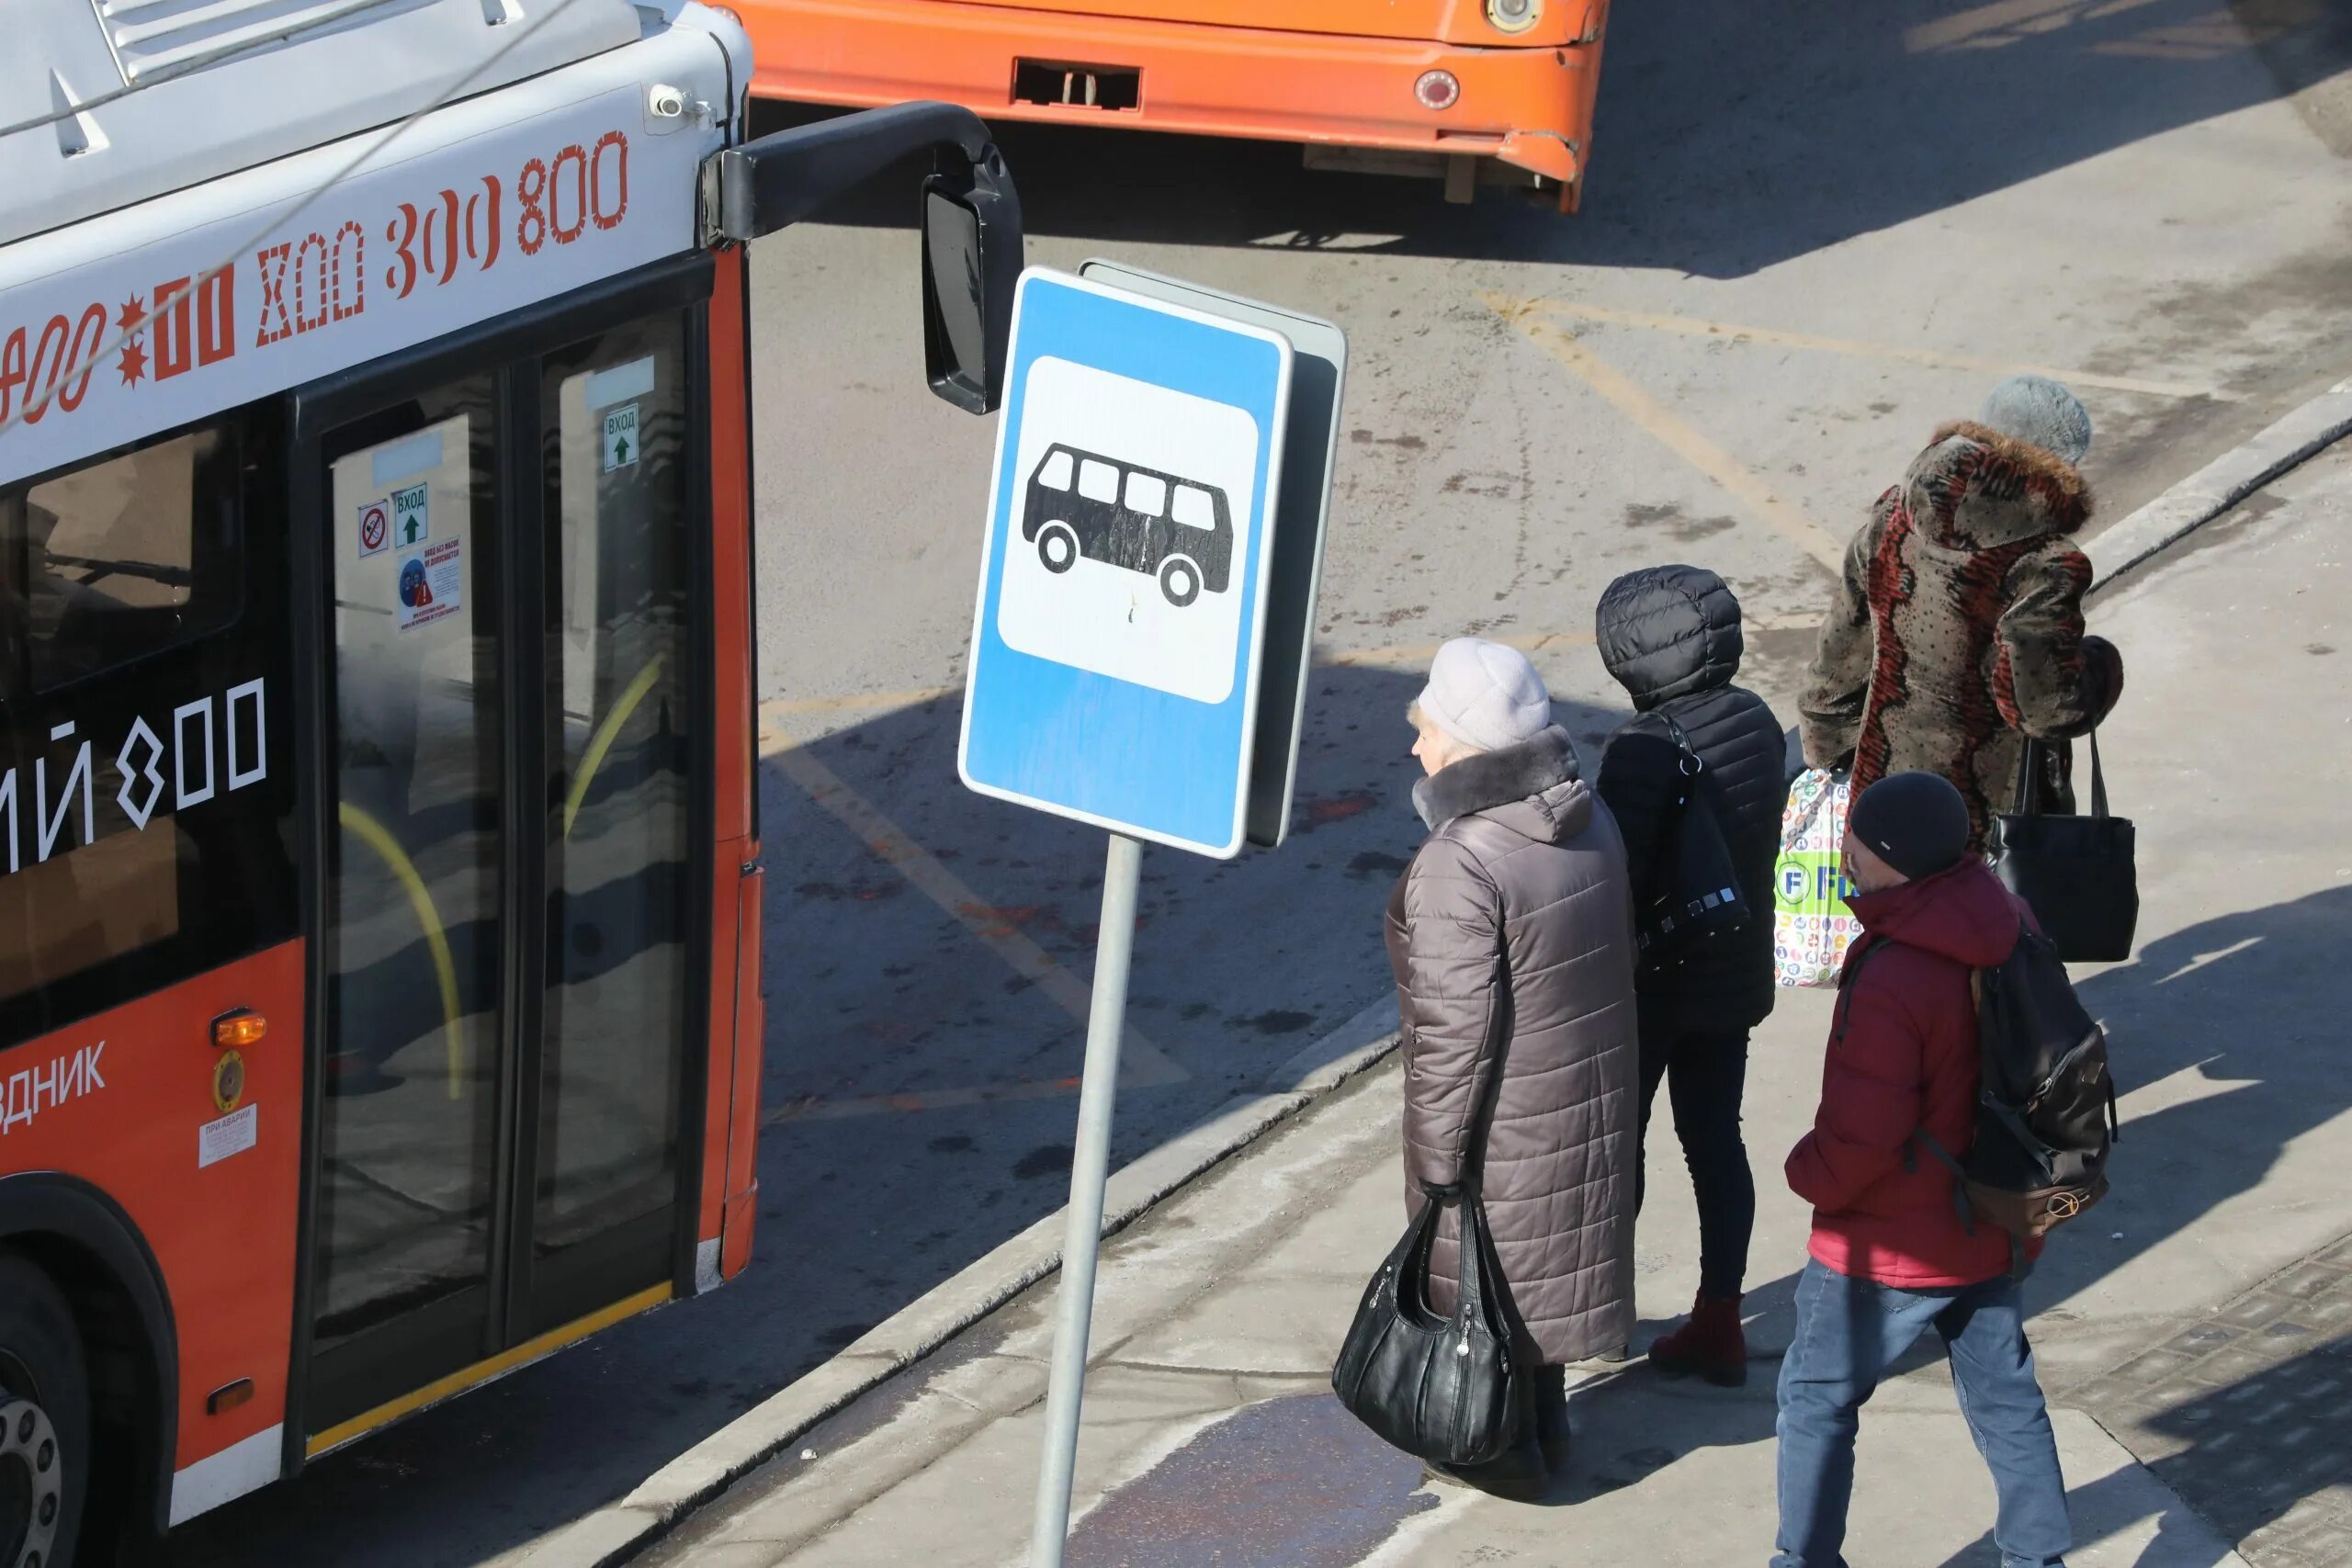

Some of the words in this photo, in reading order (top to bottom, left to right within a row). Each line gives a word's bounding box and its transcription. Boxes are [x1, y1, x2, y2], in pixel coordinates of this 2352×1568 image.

[517, 130, 628, 256] 800
[608, 412, 635, 434] ВХОД
[398, 490, 424, 513] ВХОД
[115, 676, 266, 831] 800
[1785, 872, 1802, 895] F
[1817, 865, 1860, 901] Fi
[0, 1040, 107, 1135] ДНИК
[205, 1122, 220, 1135] ПРИ
[221, 1109, 251, 1128] АВАРИИ
